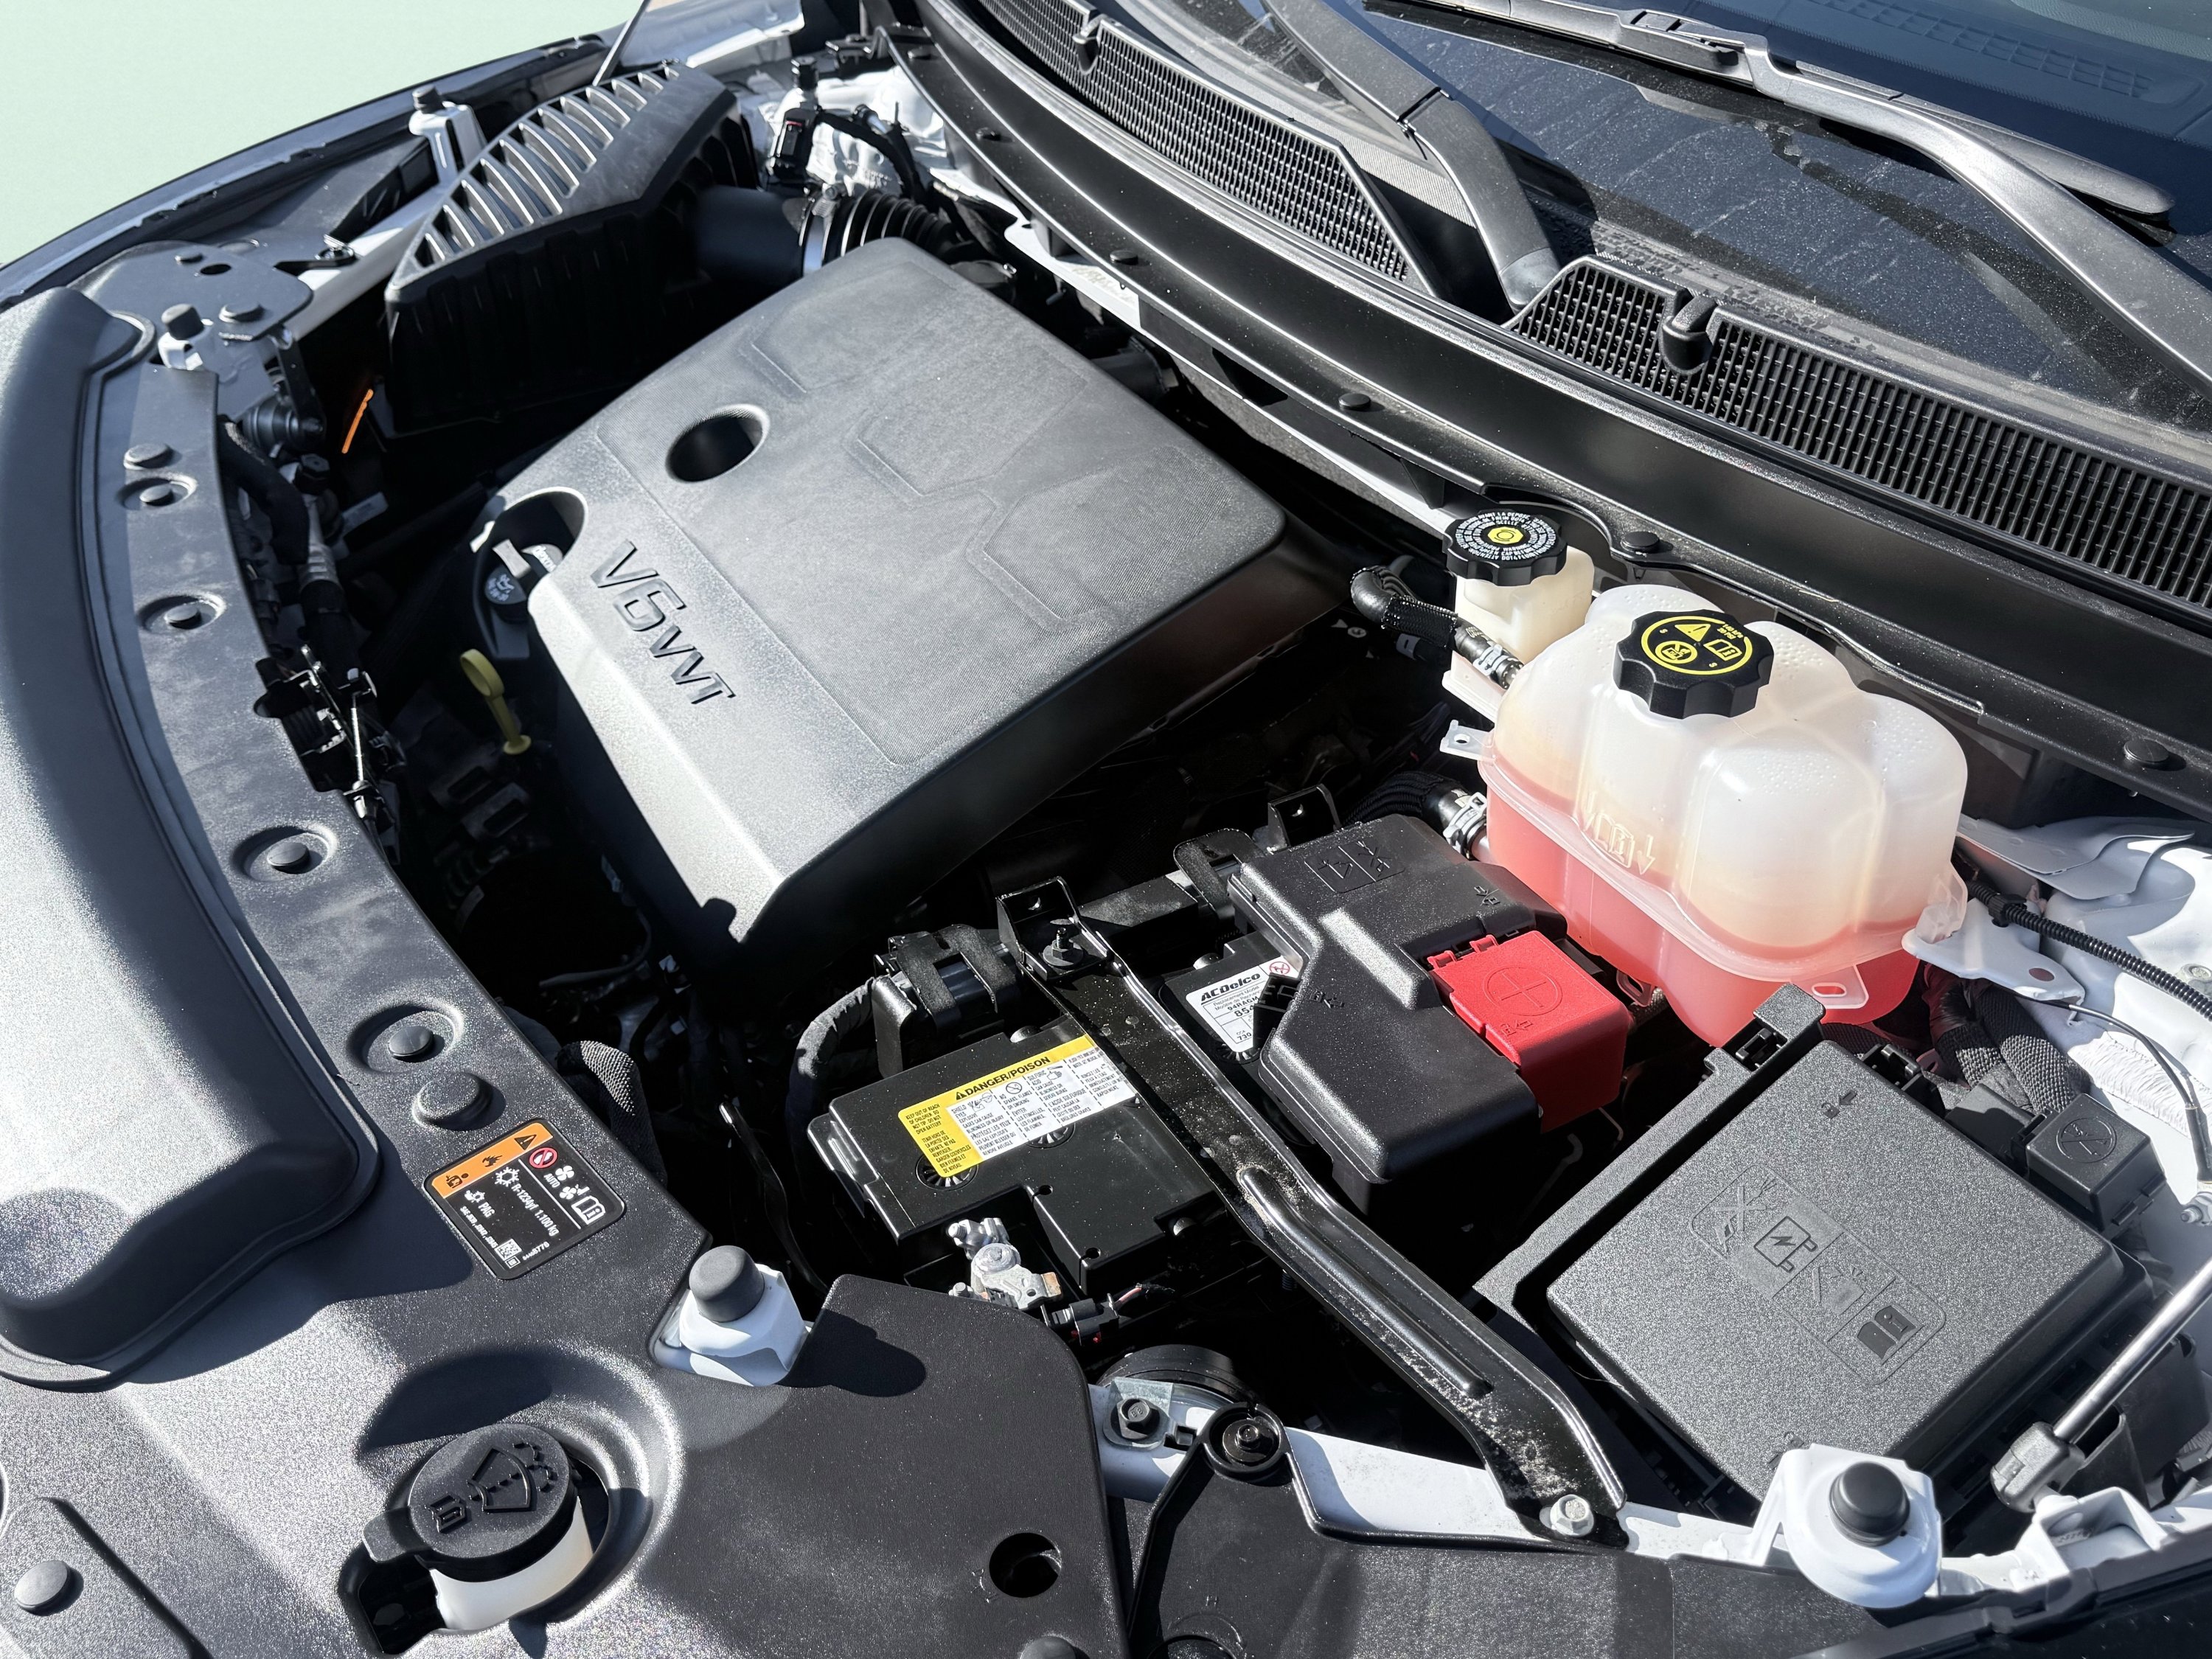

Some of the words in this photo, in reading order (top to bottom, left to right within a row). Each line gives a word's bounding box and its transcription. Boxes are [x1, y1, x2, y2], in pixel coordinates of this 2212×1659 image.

[590, 538, 687, 632] V6
[649, 625, 737, 705] VVT
[1201, 973, 1261, 1001] ACDelco
[1237, 1032, 1252, 1040] 730
[964, 1055, 1050, 1096] DANGER/POISON
[543, 1172, 560, 1188] AUTO
[477, 1202, 495, 1217] PAG
[509, 1183, 539, 1211] R-1234yf
[533, 1209, 554, 1228] 1.100
[546, 1225, 561, 1237] kg
